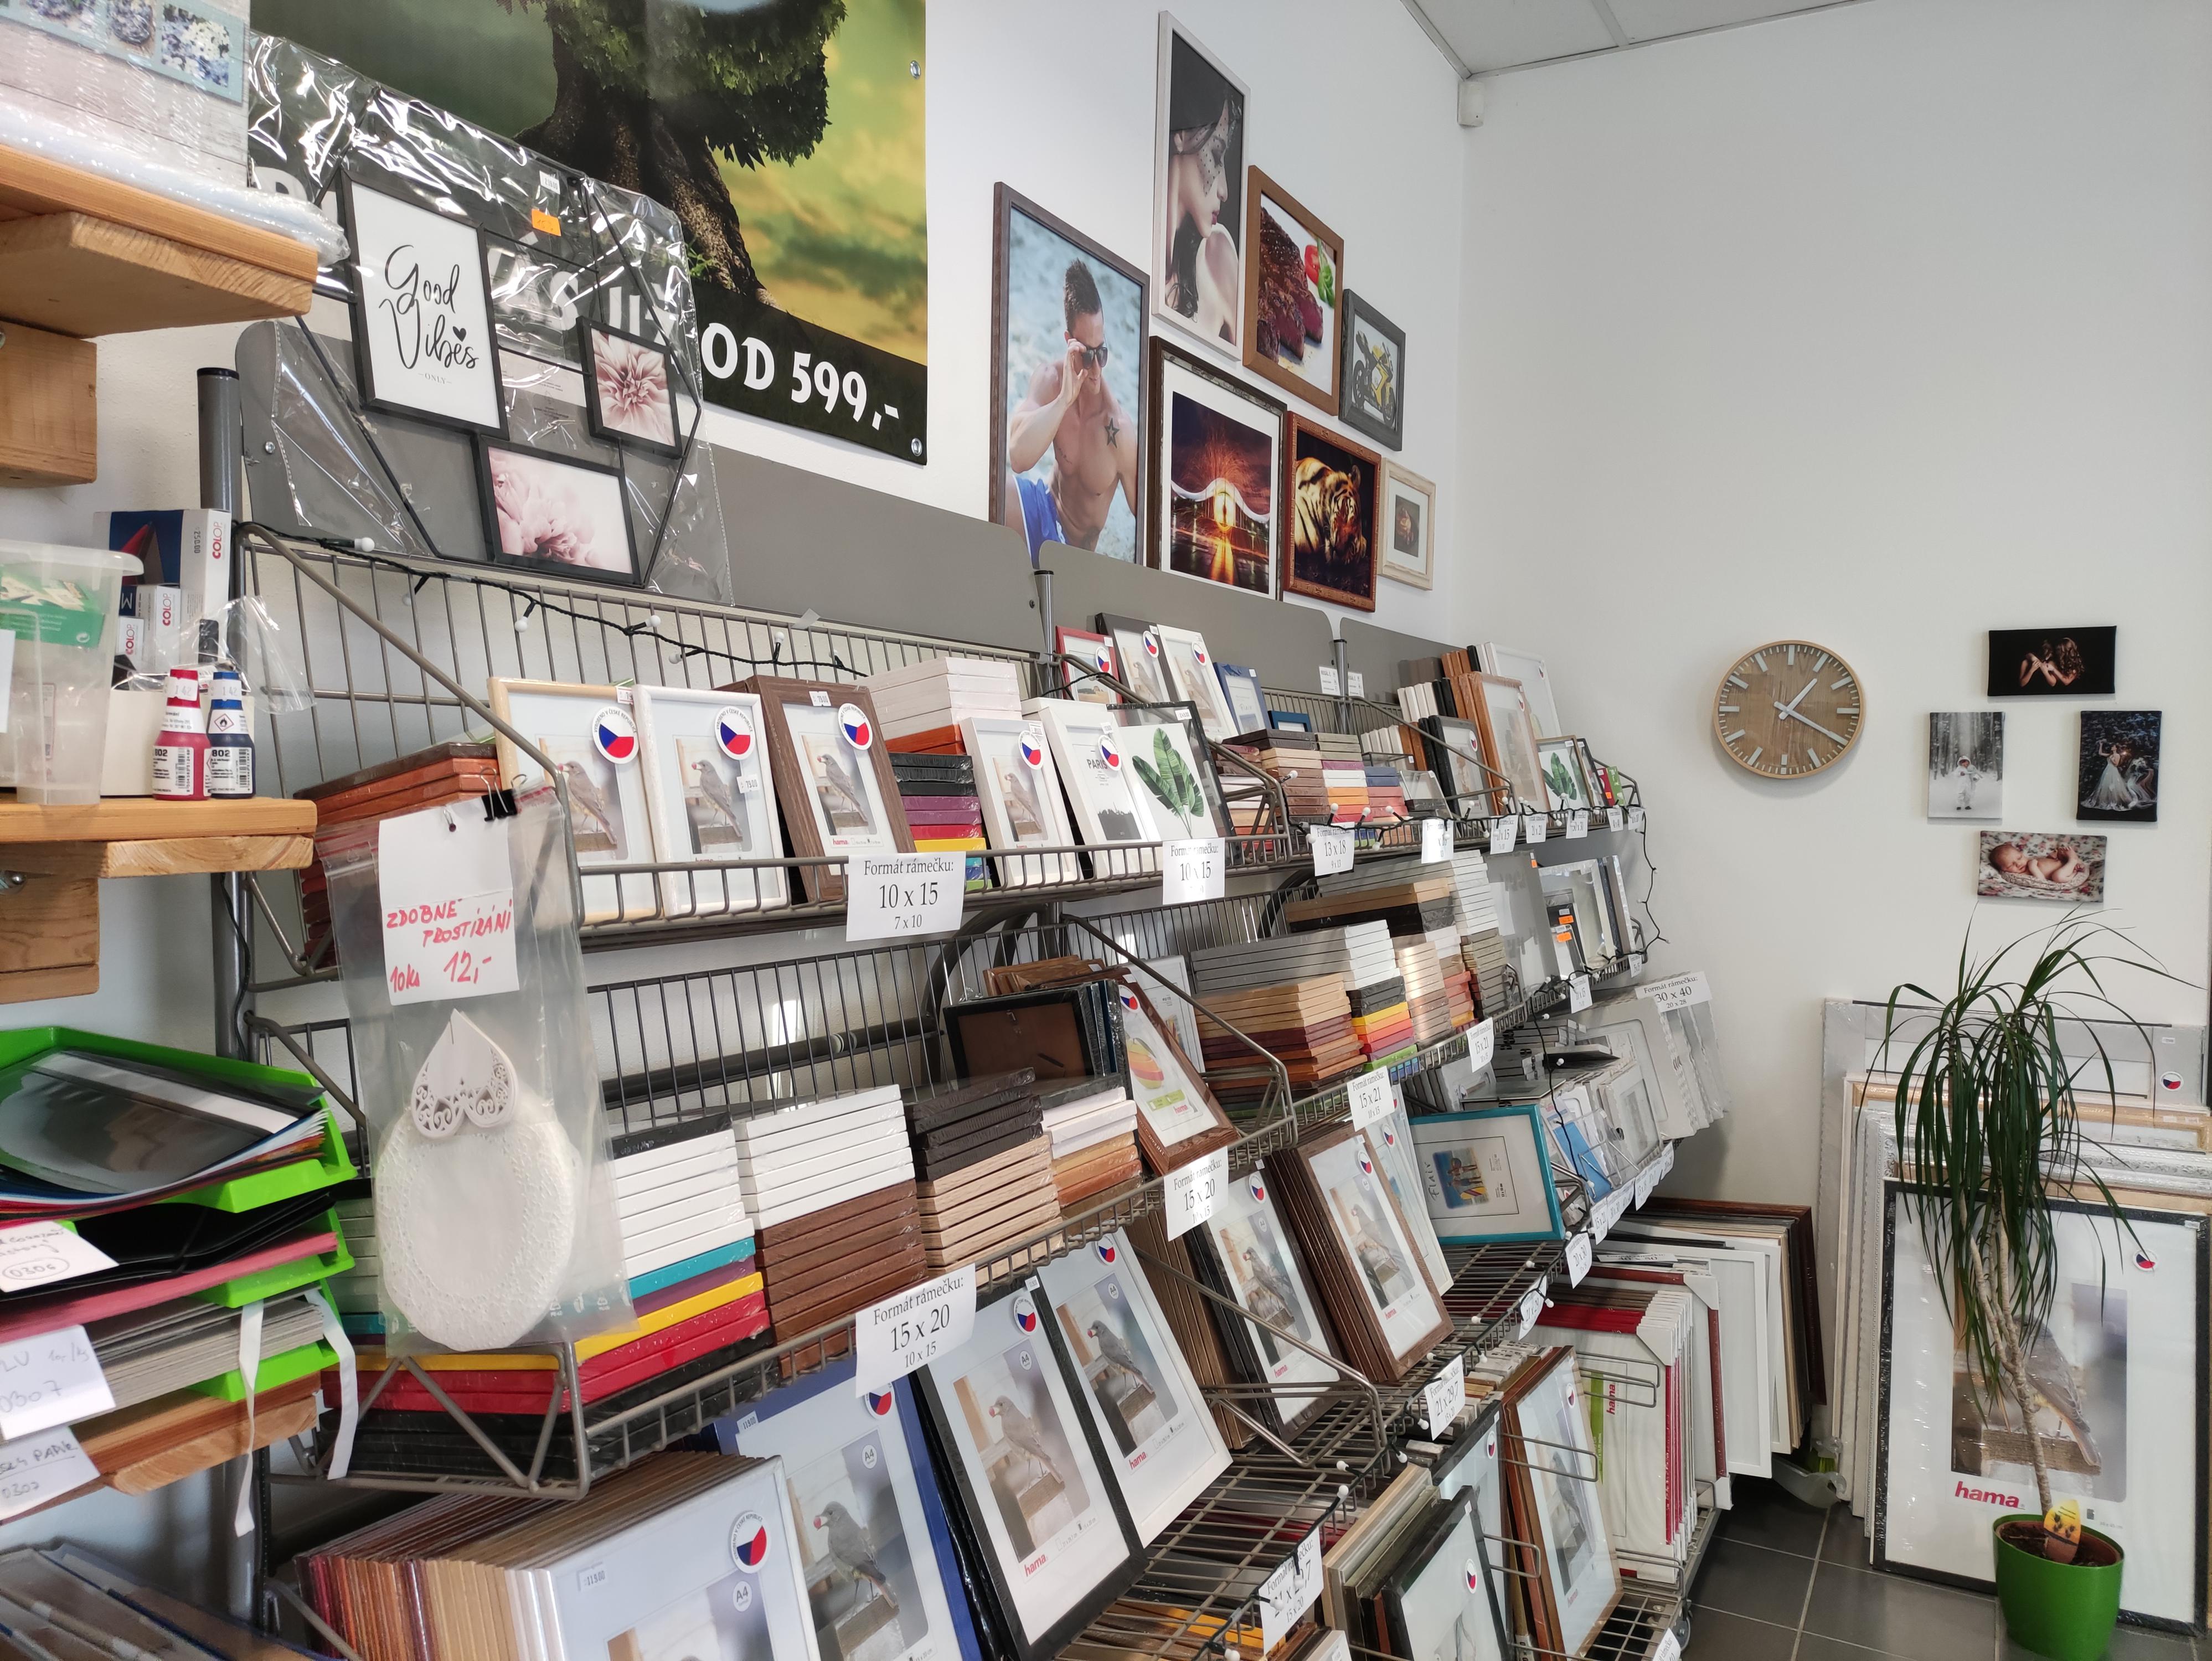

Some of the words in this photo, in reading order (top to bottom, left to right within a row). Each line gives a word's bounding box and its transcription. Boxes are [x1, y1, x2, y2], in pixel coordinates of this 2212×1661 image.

[385, 245, 460, 315] Good
[379, 297, 479, 369] Vibes
[701, 322, 775, 390] OD
[213, 522, 221, 559] COLOP
[163, 593, 172, 626] COLOP
[125, 624, 135, 655] COLOP
[1086, 759, 1107, 769] PARIS
[1324, 841, 1332, 857] 13
[1333, 845, 1338, 855] x
[1339, 839, 1346, 855] 18
[864, 859, 904, 876] Formát
[906, 857, 954, 874] rámečku:
[1180, 863, 1191, 881] 10
[1202, 860, 1211, 879] 15
[879, 884, 899, 909] 10
[904, 890, 914, 907] x
[920, 881, 938, 906] 15
[895, 916, 901, 930] 7
[903, 919, 909, 929] x
[911, 914, 922, 928] 10
[1644, 984, 1667, 994] Formát
[1668, 976, 1698, 988] rámečku:
[1654, 992, 1668, 1003] 30
[1680, 986, 1692, 997] 40
[1475, 1041, 1481, 1054] 15
[1352, 1080, 1368, 1092] Formát
[1359, 1092, 1368, 1108] 15
[1368, 1093, 1373, 1105] x
[1373, 1086, 1381, 1102] 21
[1184, 1189, 1195, 1211] 15
[1205, 1178, 1215, 1200] 20
[874, 1294, 913, 1326] Formát
[916, 1277, 964, 1307] rámečku:
[890, 1321, 910, 1353] 15
[915, 1321, 925, 1341] x
[930, 1304, 950, 1333] 20
[905, 1352, 915, 1368] 10
[917, 1350, 924, 1362] x
[926, 1341, 936, 1358] 15
[1021, 1353, 1030, 1365] A4
[1273, 1364, 1288, 1378] hama
[1436, 1397, 1443, 1417] 21
[1606, 1383, 1616, 1415] hama
[864, 1448, 875, 1462] A4
[1129, 1451, 1147, 1470] hama
[1955, 1481, 2020, 1509] hama
[1024, 1554, 1046, 1577] hama
[1267, 1563, 1288, 1595] Formát
[736, 1586, 749, 1603] A4
